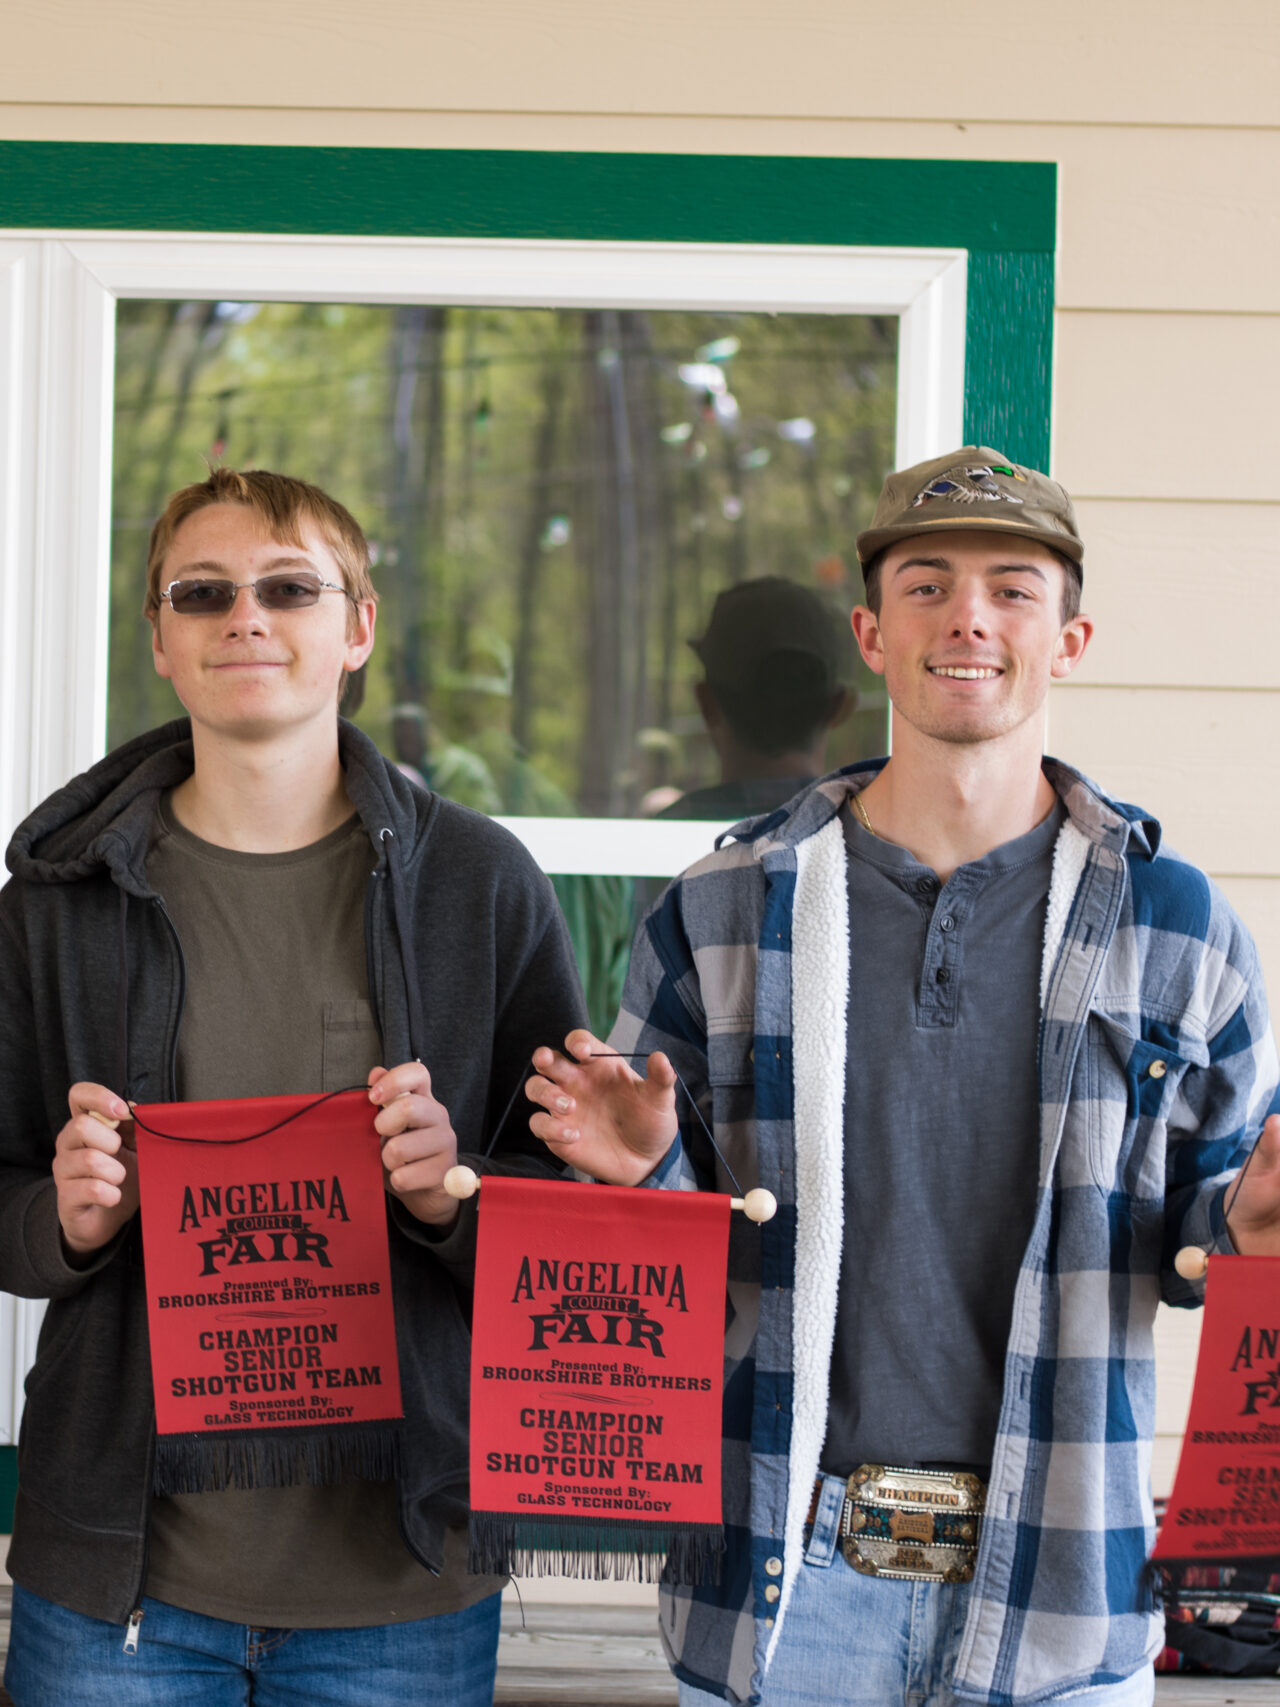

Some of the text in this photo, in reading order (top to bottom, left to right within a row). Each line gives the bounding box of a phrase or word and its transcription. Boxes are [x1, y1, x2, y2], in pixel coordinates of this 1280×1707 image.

[179, 1176, 350, 1233] ANGELINA
[234, 1216, 294, 1231] COUNTY
[197, 1232, 333, 1276] FAIR
[158, 1282, 380, 1309] BROOKSHIRE BROTHERS
[223, 1277, 313, 1291] Presented By:
[512, 1256, 689, 1312] ANGELINA
[568, 1296, 630, 1311] COUNTY
[199, 1324, 338, 1351] CHAMPION
[527, 1313, 666, 1358] FAIR
[224, 1346, 323, 1372] SENIOR
[551, 1359, 644, 1374] Presented By:
[171, 1366, 382, 1398] SHOTGUN TEAM
[482, 1366, 711, 1391] BROOKSHIRE BROTHERS
[204, 1407, 354, 1425] GLASS TECHNOLOGY
[229, 1396, 333, 1411] Sponsored By:
[520, 1408, 663, 1435] CHAMPION
[543, 1431, 644, 1458] SENIOR
[486, 1453, 703, 1484] SHOTGUN TEAM
[517, 1493, 672, 1512] GLASS TECHNOLOGY
[544, 1481, 651, 1498] Sponsored By:
[875, 1487, 959, 1506] CHAMPION
